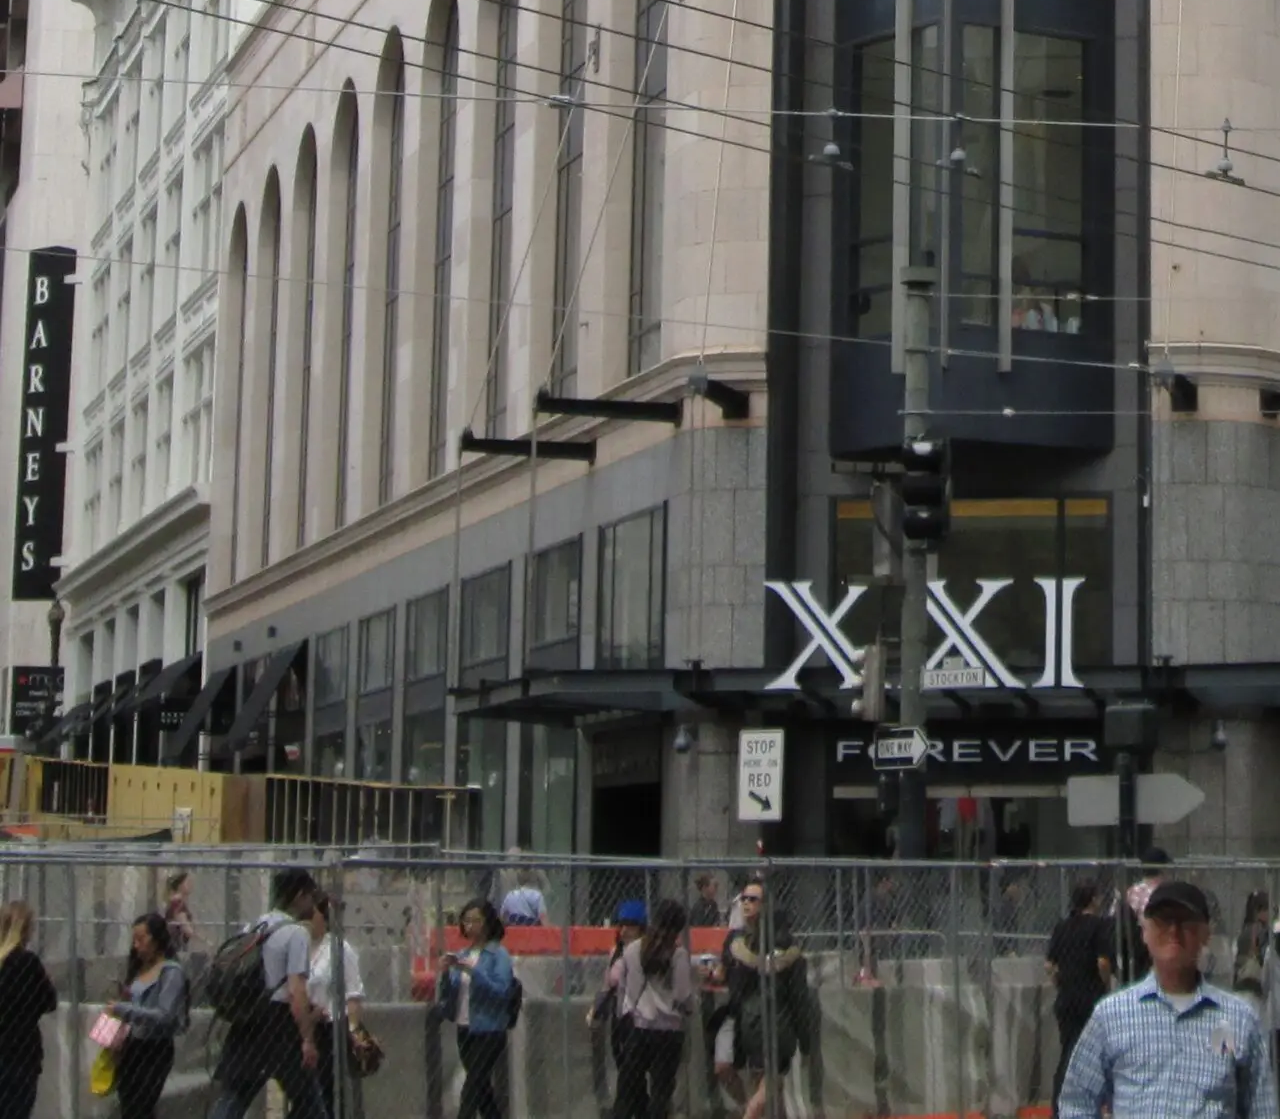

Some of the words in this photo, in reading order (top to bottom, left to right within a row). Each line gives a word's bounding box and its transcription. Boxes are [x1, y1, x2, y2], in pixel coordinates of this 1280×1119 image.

[21, 276, 49, 572] BARNEYS
[763, 578, 1086, 690] XXI
[929, 671, 980, 686] STOCKTON
[746, 740, 776, 755] STOP
[837, 740, 1099, 762] FREVER
[880, 742, 895, 757] ONE
[897, 740, 913, 755] WAY
[748, 773, 772, 788] RED
